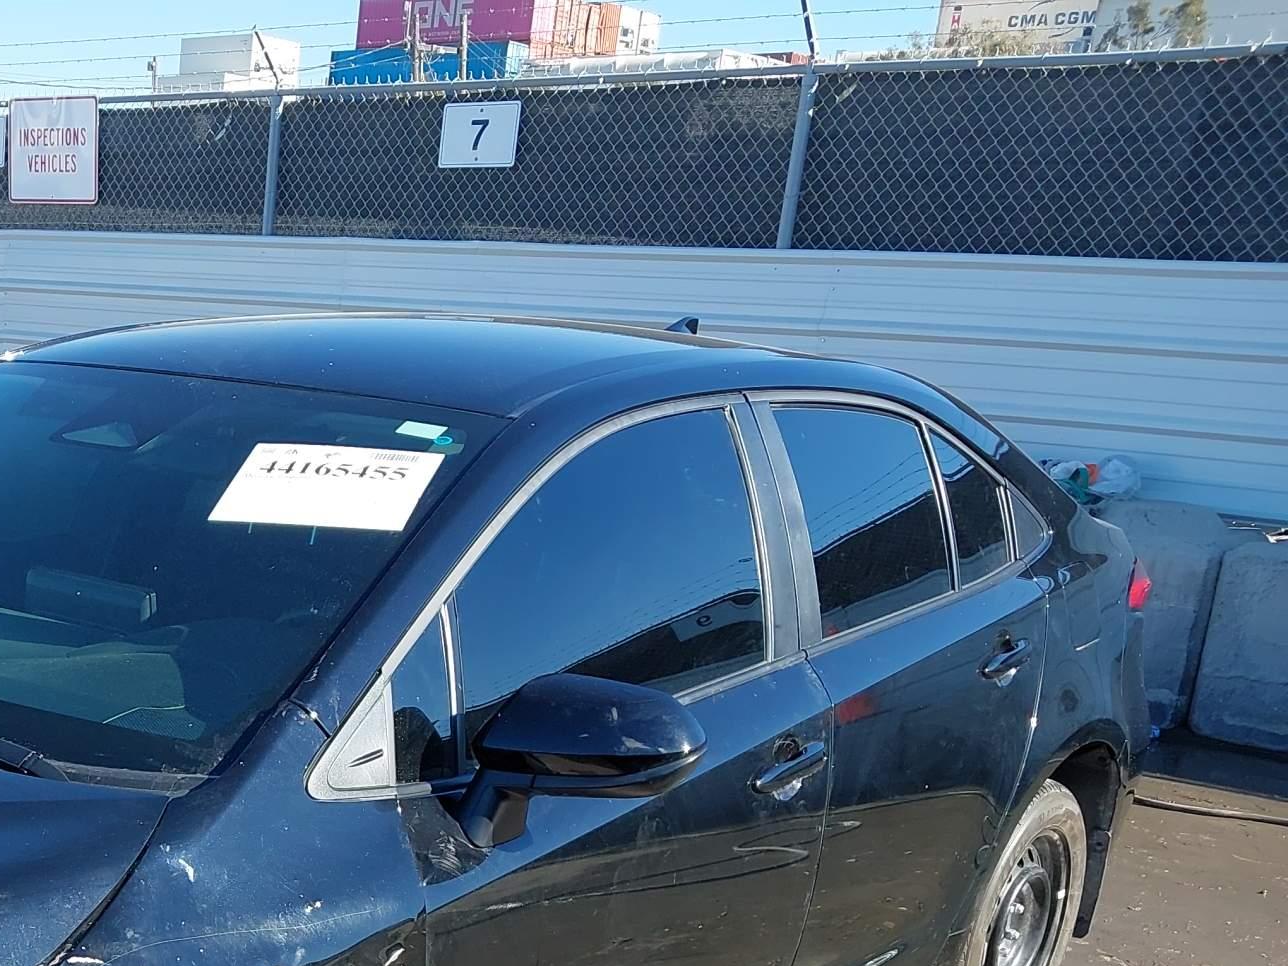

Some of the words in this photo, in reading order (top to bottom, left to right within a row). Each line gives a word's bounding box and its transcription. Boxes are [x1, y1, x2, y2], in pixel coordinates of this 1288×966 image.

[1008, 13, 1048, 28] CMA
[1054, 10, 1096, 26] CGM
[19, 127, 87, 147] INSPECTIONS
[471, 119, 490, 151] 7
[27, 154, 78, 173] VEHICLES
[259, 460, 409, 481] 44165455
